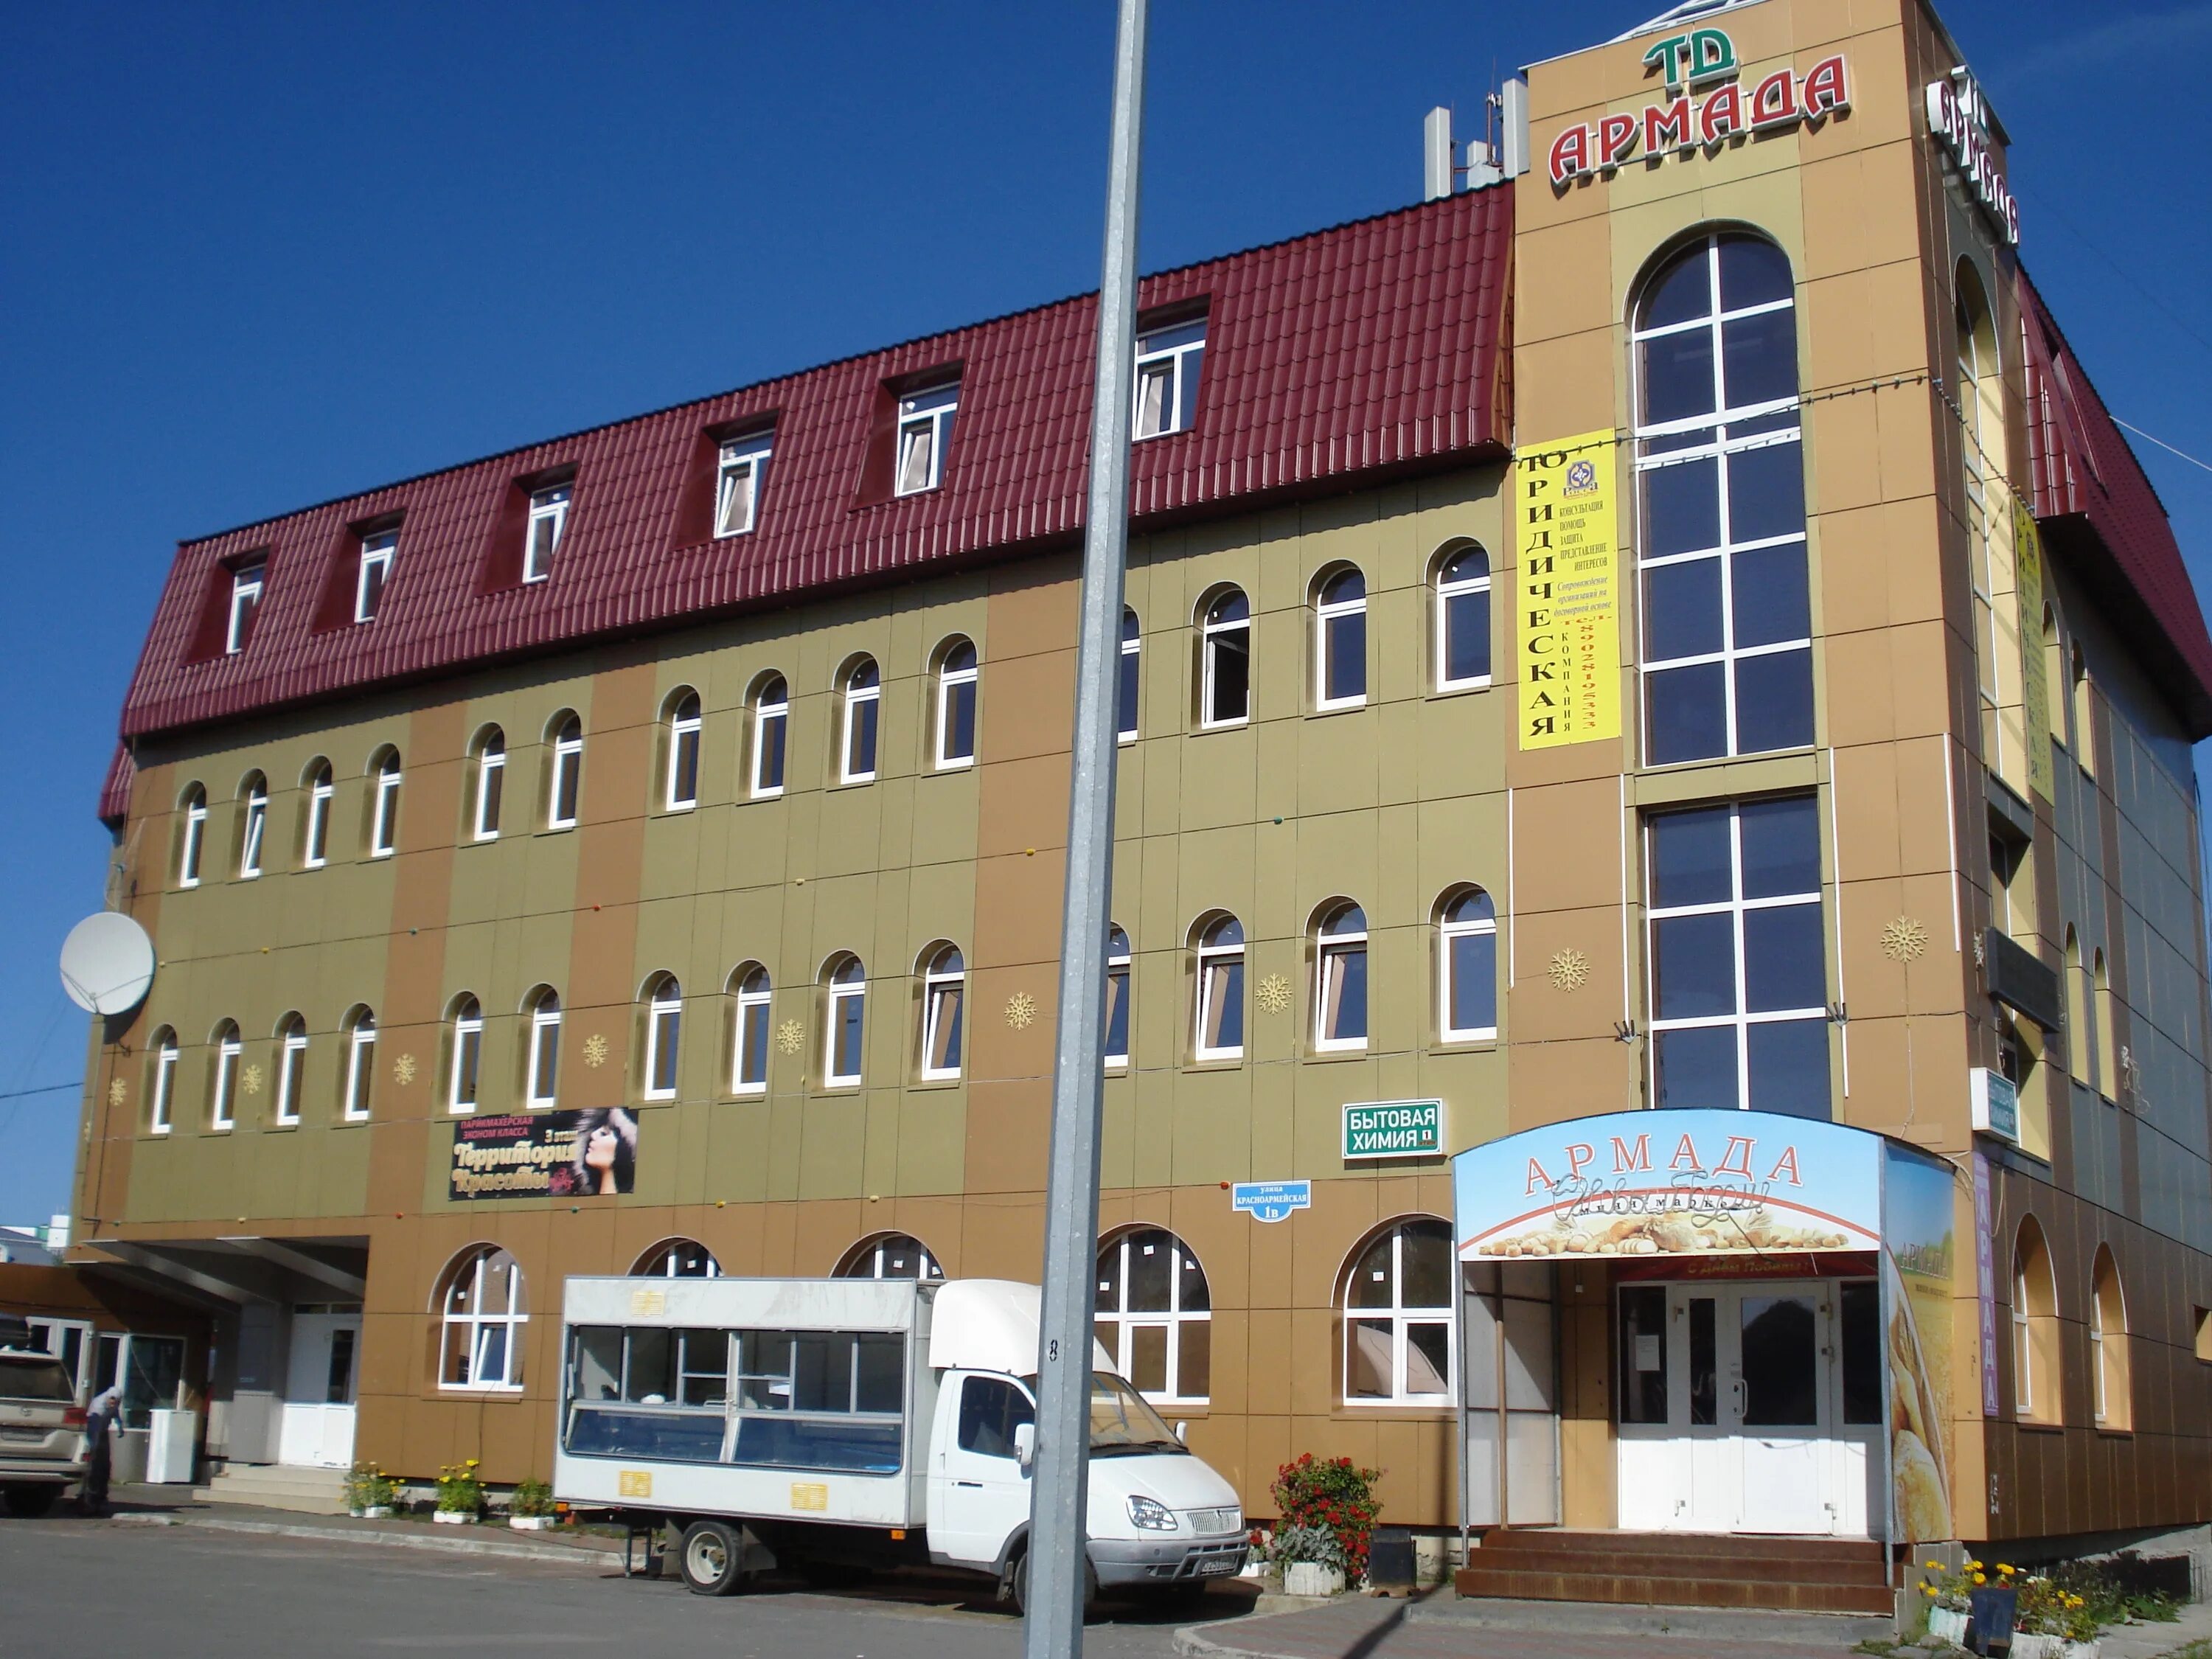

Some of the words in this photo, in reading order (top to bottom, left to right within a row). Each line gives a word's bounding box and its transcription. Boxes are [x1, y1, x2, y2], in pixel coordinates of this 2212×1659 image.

[1549, 54, 1849, 189] АРМАДА
[1559, 501, 1604, 518] КОНСУЛЬТАЦИЯ
[1559, 518, 1586, 531] ПОМОЩЬ
[1560, 533, 1584, 546] ЗАЩИТА
[1560, 543, 1607, 560] ПРЕДСТАВЛЕНИЕ
[1574, 557, 1608, 571] ИНТЕРЕСОВ
[1526, 451, 1568, 737] ЮРИДИЧЕСКАЯ
[1562, 633, 1571, 731] КОМПАНИЯ
[461, 1116, 534, 1130] ПАРИКМАХЕРСКАЯ
[1350, 1107, 1436, 1130] БЫТОВАЯ
[463, 1128, 496, 1140] ЭКОНОМ
[497, 1127, 529, 1138] КЛАССА
[544, 1129, 552, 1143] 3
[1352, 1129, 1417, 1150] ХИМИЯ
[453, 1141, 580, 1172] Территория
[1525, 1133, 1804, 1197] АРМАДА
[451, 1166, 550, 1198] Красоты
[1259, 1183, 1283, 1194] улица
[1237, 1193, 1307, 1205] КРАСНОАРМЕЙСКАЯ
[1978, 1193, 1995, 1408] АРМАДА
